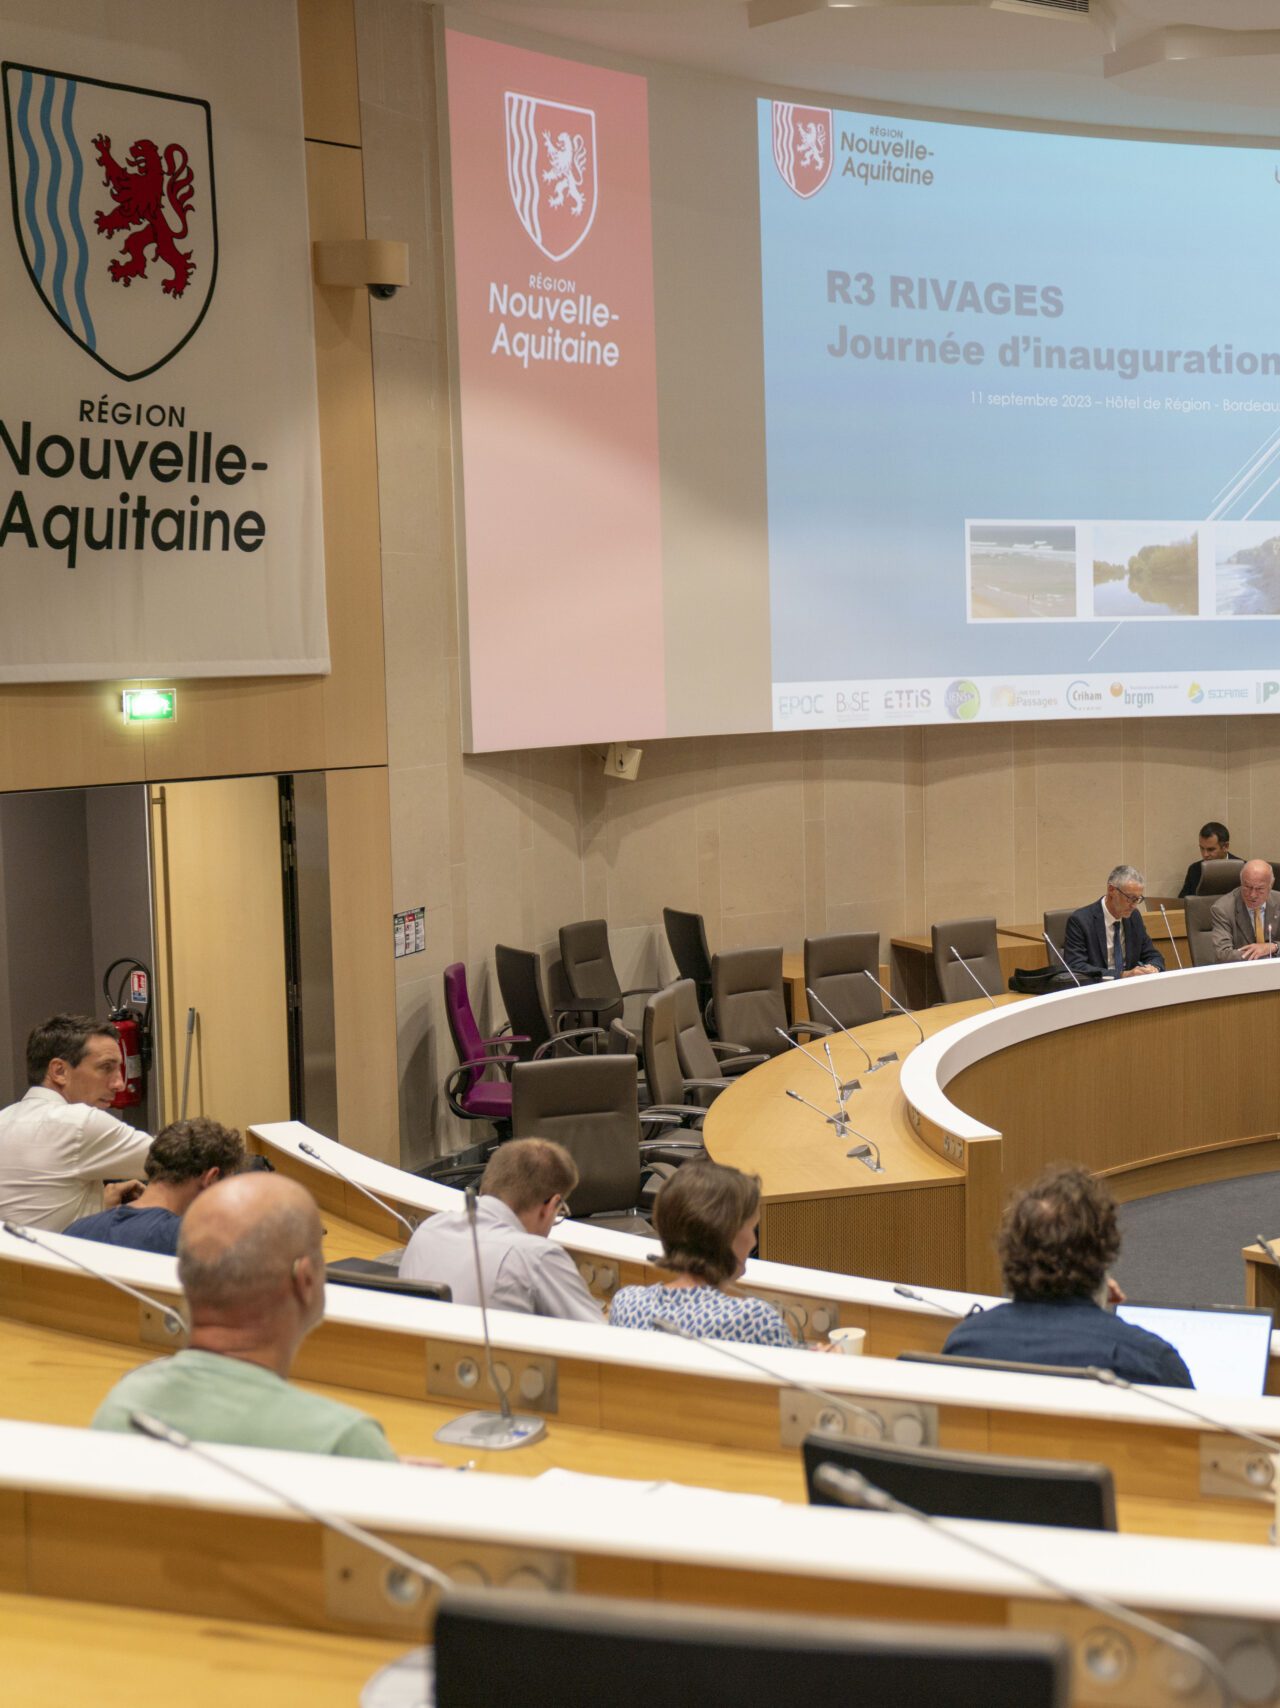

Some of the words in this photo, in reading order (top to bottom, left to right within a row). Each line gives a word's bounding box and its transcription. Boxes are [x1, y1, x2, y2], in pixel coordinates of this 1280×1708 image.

[841, 130, 935, 161] Nouvelle-
[869, 125, 903, 138] RÉGION
[841, 156, 935, 186] Aquitaine
[528, 271, 576, 294] RÉGION
[826, 269, 876, 307] R3
[889, 274, 1065, 319] RIVAGES
[488, 282, 620, 328] Nouvelle-
[491, 321, 620, 369] Aquitaine
[826, 324, 986, 366] Journée
[79, 394, 186, 428] RÉGION
[970, 390, 983, 405] 11
[987, 391, 1058, 408] septembre
[1062, 394, 1092, 408] 2023
[1105, 395, 1140, 409] Hôtel
[1144, 396, 1161, 410] de
[1165, 397, 1211, 413] Région
[0, 419, 268, 486] Nouvelle-
[0, 490, 266, 569] Aquitaine
[779, 694, 824, 714] EPOC
[1072, 690, 1102, 701] Criham
[1124, 689, 1154, 708] brgm
